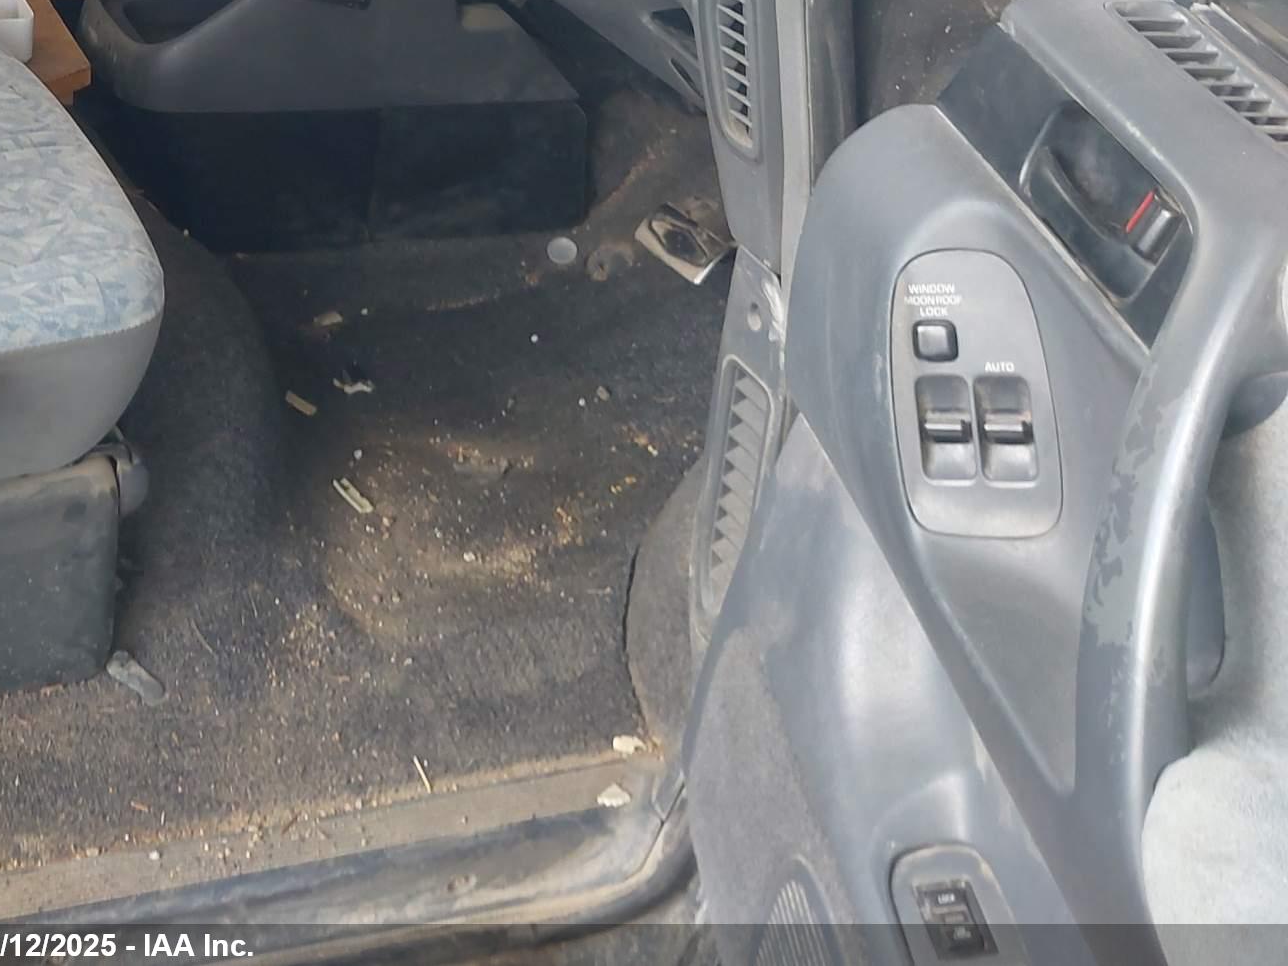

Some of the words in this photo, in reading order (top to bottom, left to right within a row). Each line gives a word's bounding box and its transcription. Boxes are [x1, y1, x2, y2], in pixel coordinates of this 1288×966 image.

[908, 283, 955, 294] WINDOW
[919, 306, 949, 317] LOCK
[984, 361, 1015, 372] AUTO
